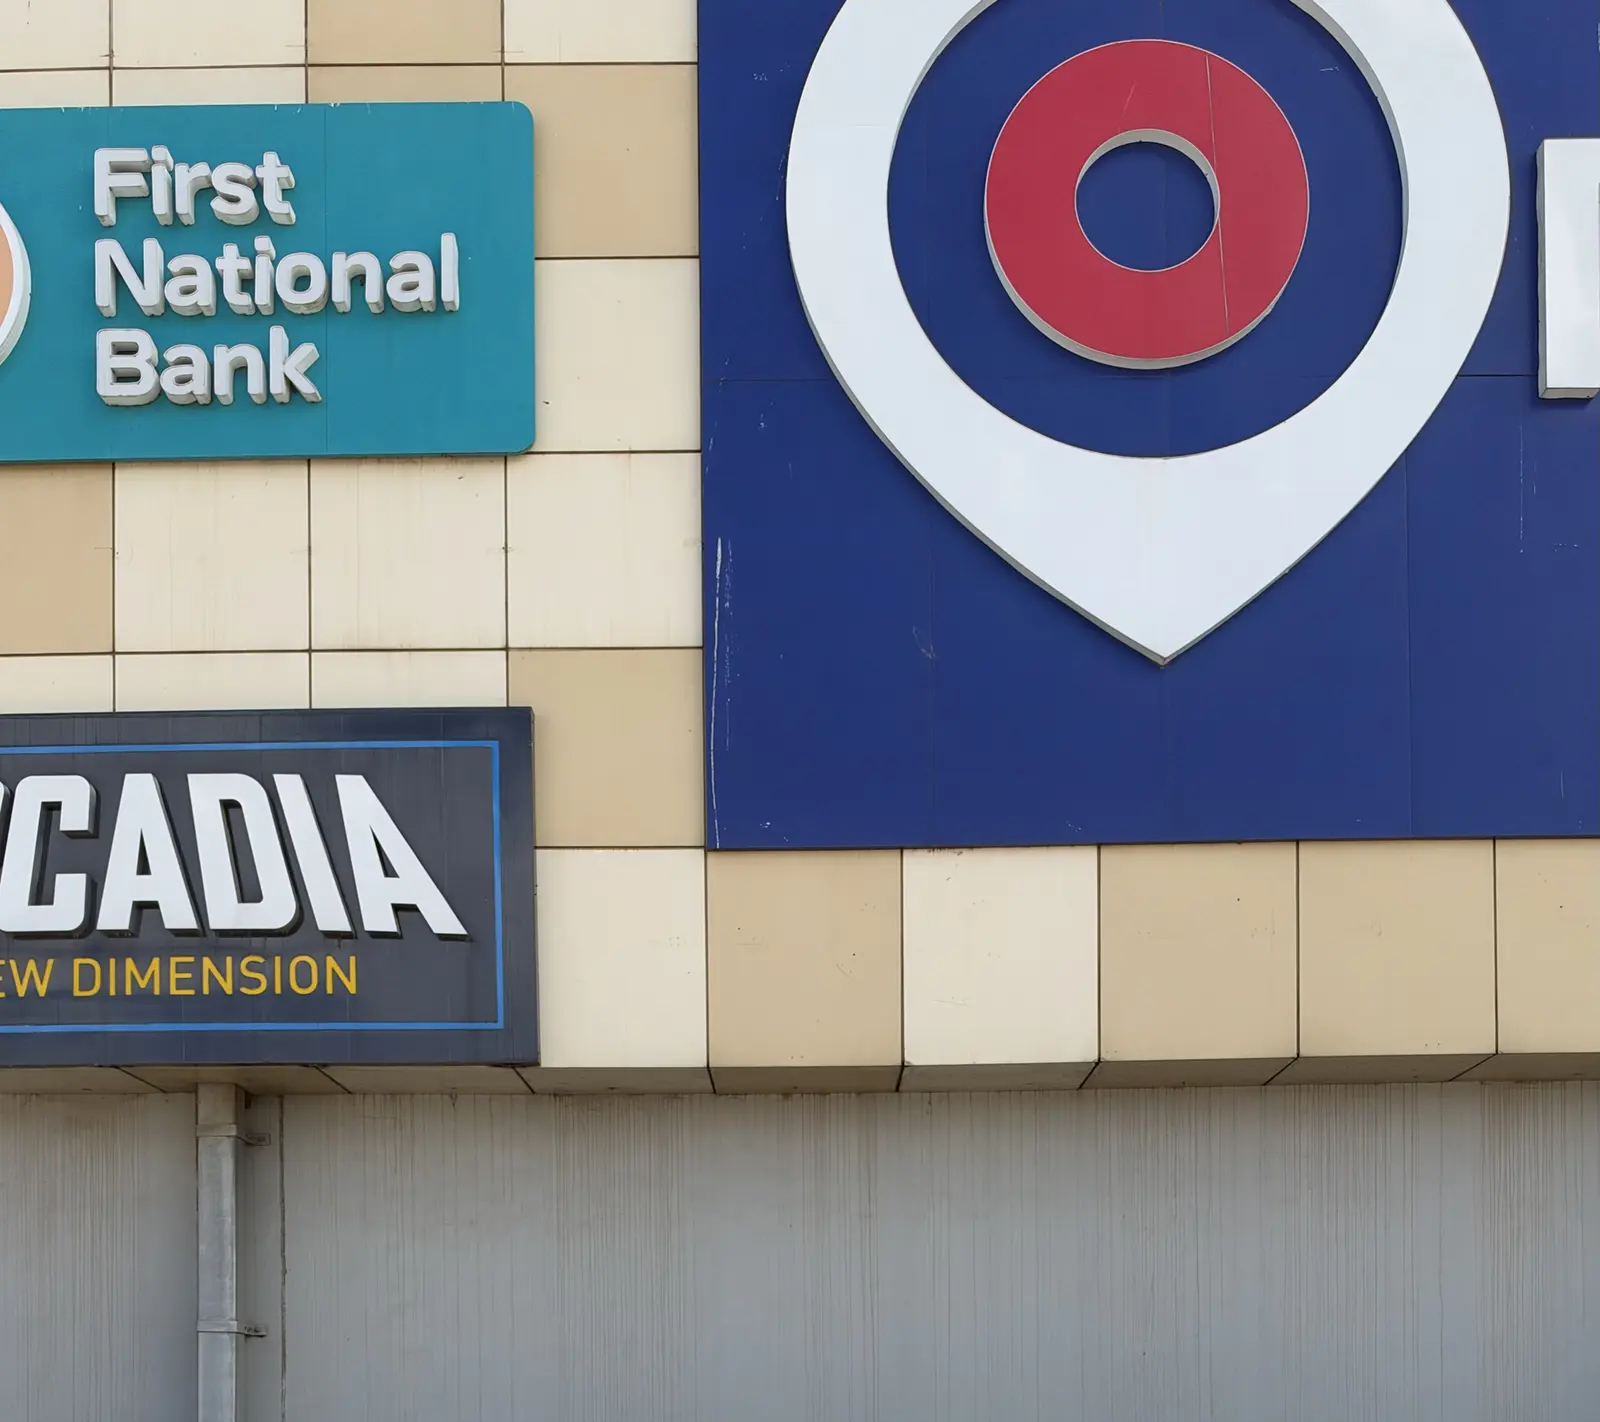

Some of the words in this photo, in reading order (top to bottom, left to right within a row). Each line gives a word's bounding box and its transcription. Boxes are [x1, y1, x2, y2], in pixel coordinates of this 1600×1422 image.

[94, 144, 297, 227] First
[94, 232, 460, 318] National
[95, 324, 323, 406] Bank
[0, 773, 473, 940] CADIA
[72, 955, 359, 997] DIMENSION
